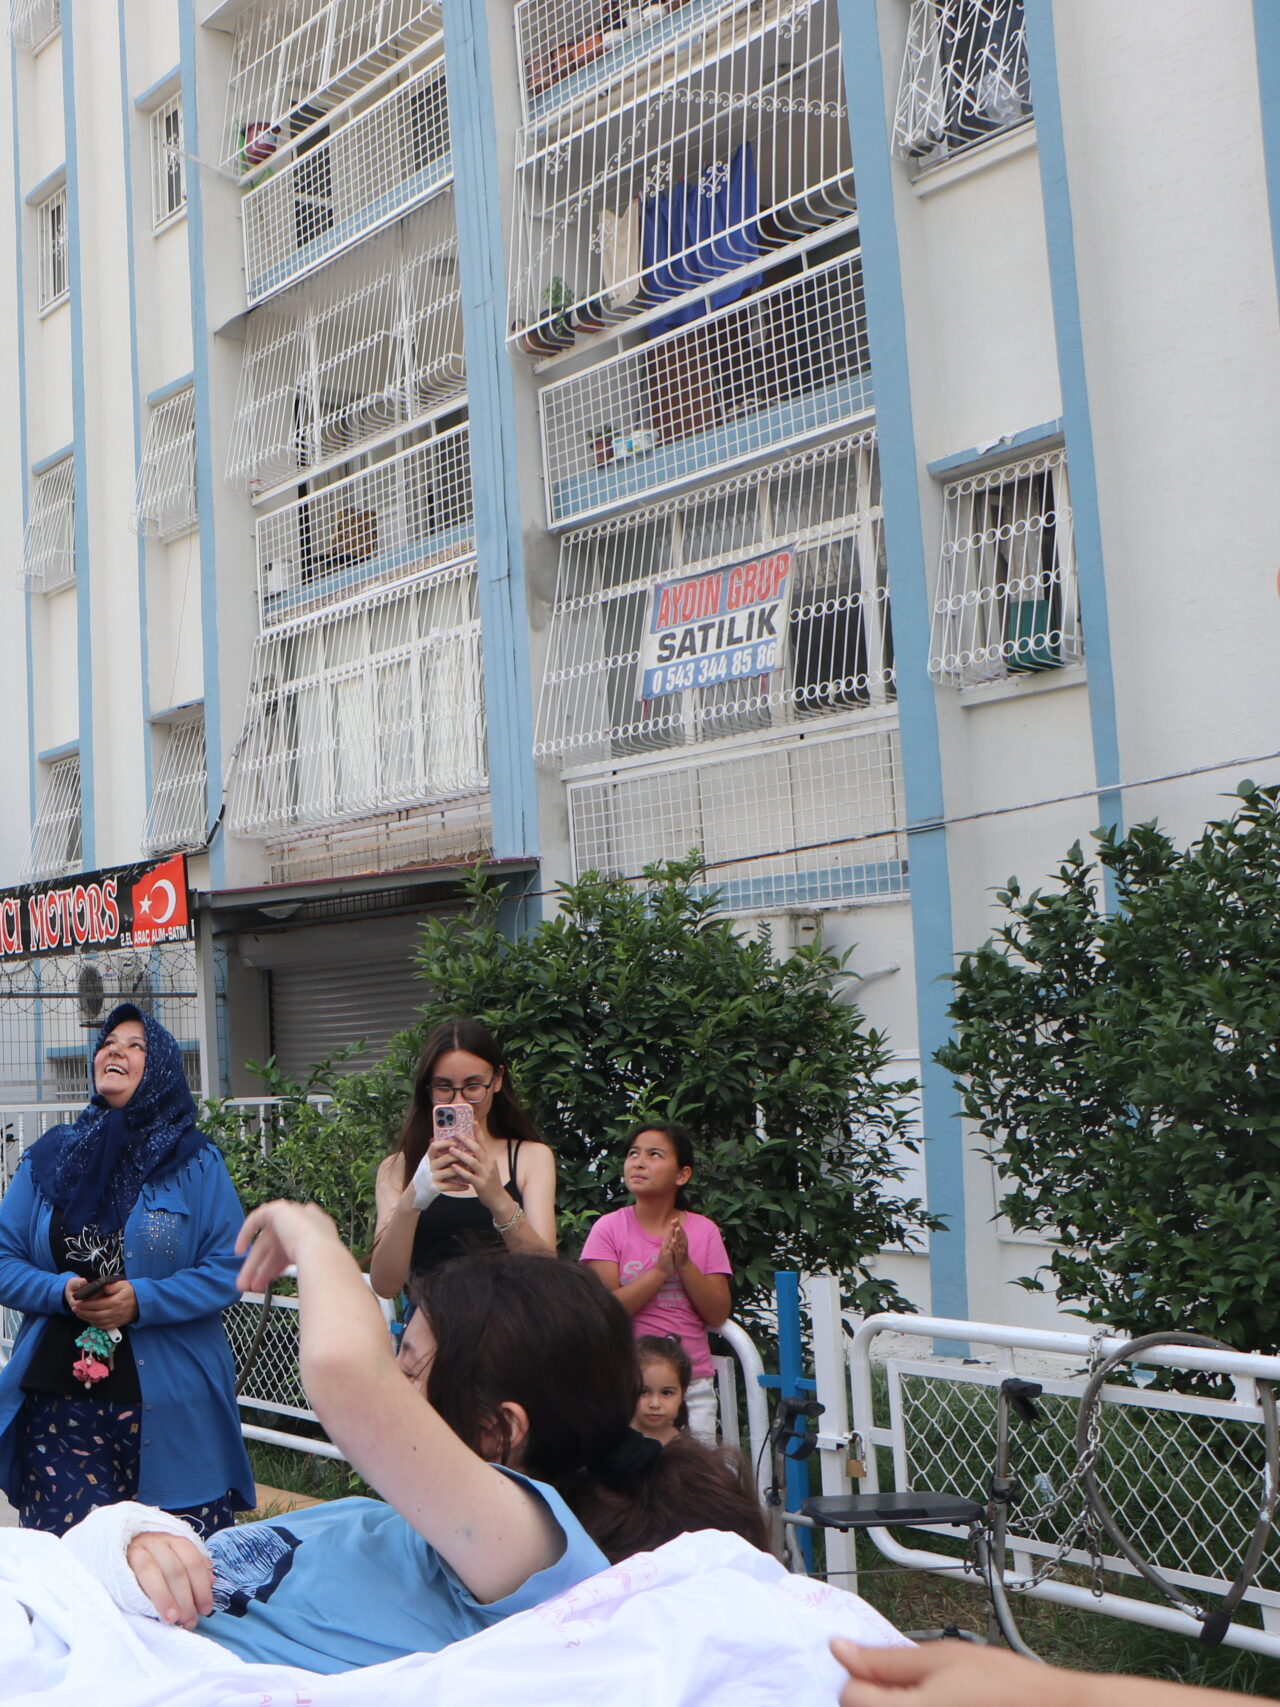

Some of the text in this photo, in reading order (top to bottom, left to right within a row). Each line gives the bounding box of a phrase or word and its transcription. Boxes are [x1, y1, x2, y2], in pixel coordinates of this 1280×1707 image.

[656, 551, 791, 631] AYDIN GRUP
[656, 603, 781, 664] SATILIK
[652, 641, 776, 694] 0 543 344 85 86
[28, 875, 120, 952] MOTORS
[134, 928, 150, 946] ARAÇ
